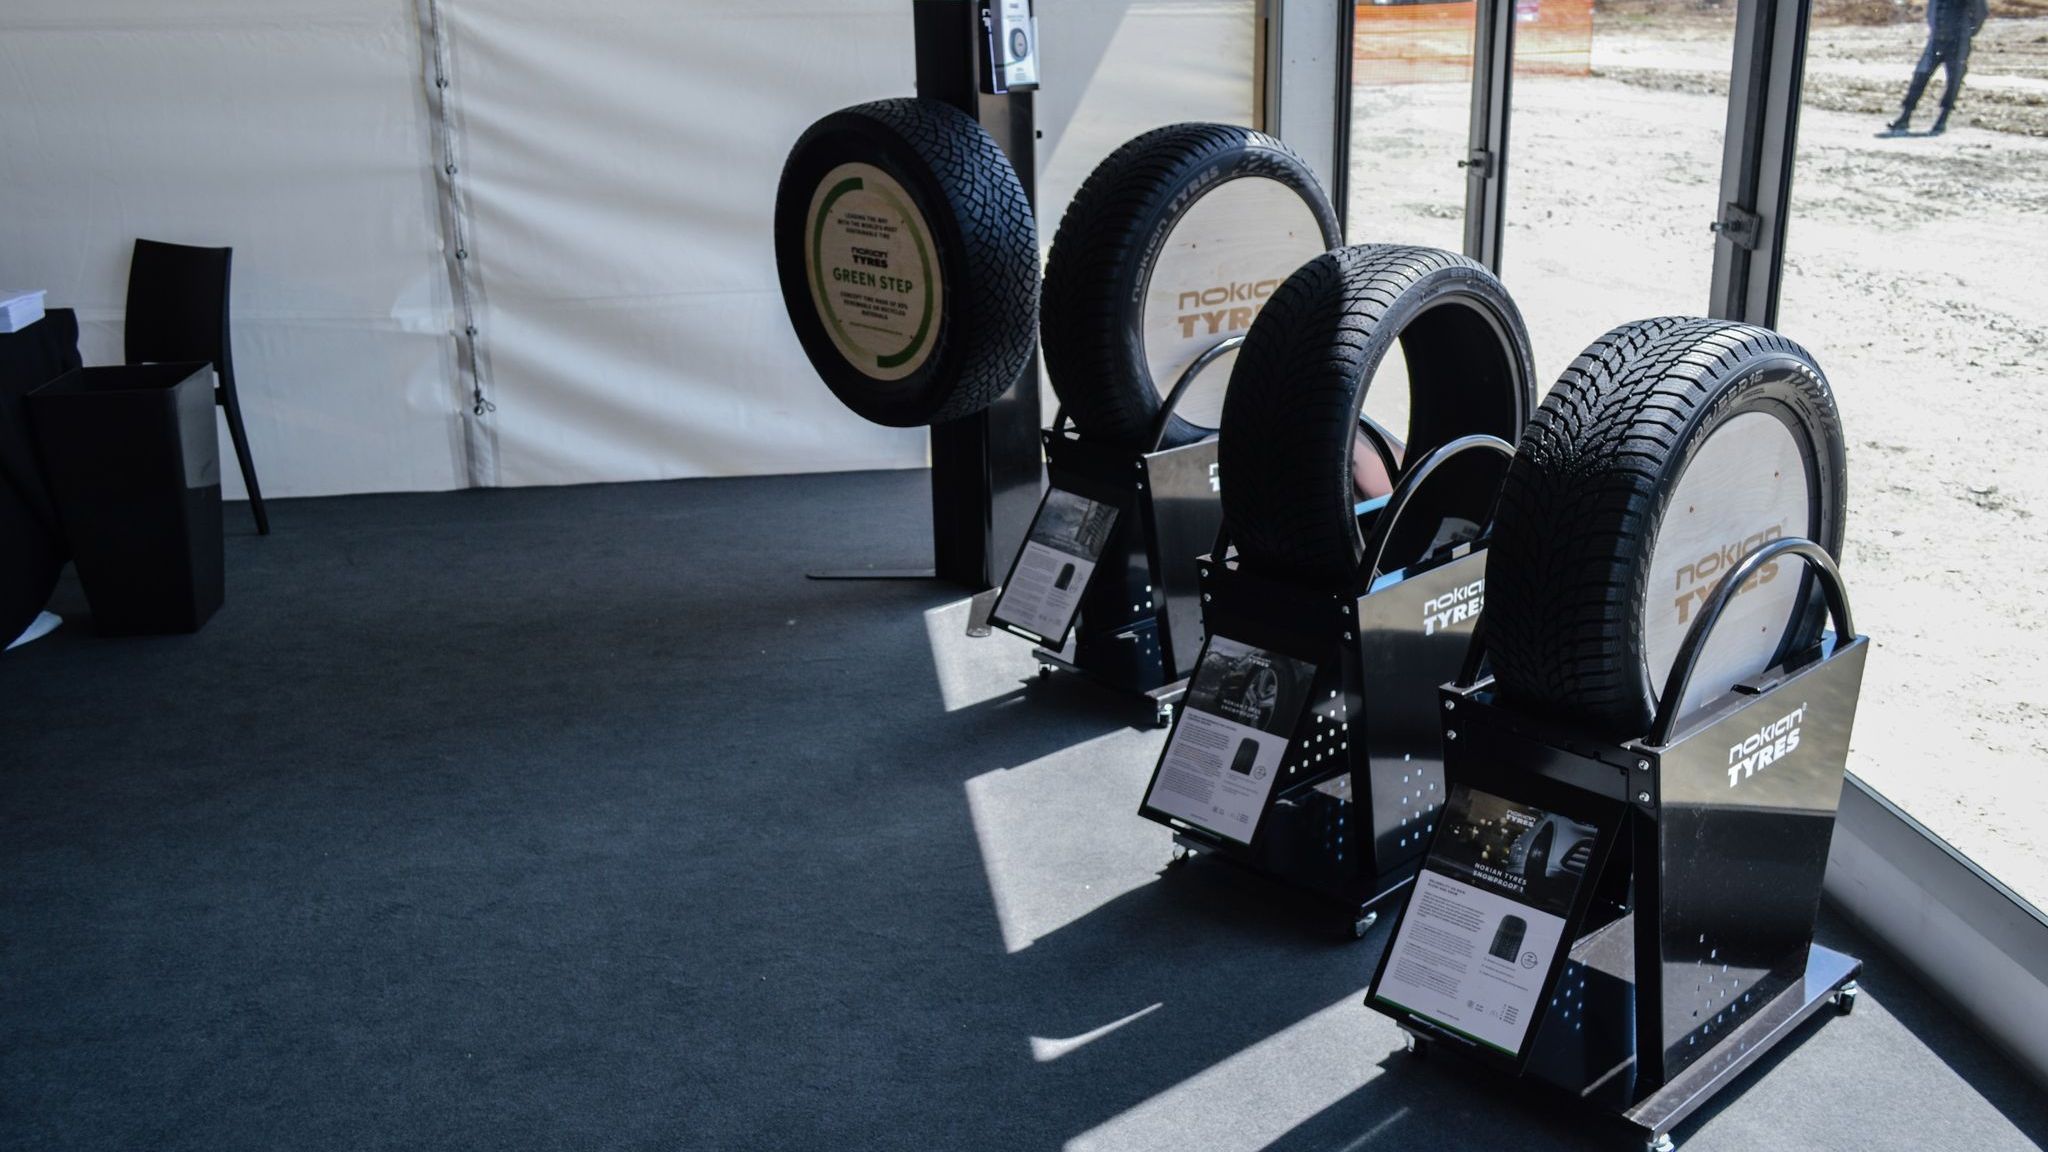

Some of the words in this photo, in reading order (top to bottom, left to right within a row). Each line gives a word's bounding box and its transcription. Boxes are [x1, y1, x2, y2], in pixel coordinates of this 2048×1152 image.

[1168, 165, 1220, 212] TYRES
[851, 246, 888, 258] nokian
[852, 254, 888, 269] TYRES
[833, 267, 876, 288] GREEN
[880, 275, 913, 294] STEP
[1178, 278, 1285, 310] nokia
[1178, 303, 1263, 339] TYR
[1424, 578, 1485, 616] nokia
[1729, 708, 1804, 764] nokian
[1727, 727, 1801, 788] TYRES
[1505, 813, 1535, 828] TYRES
[1472, 870, 1518, 892] SNOWPROOF
[1474, 862, 1503, 878] NOKIAN
[1504, 871, 1528, 886] TYRES
